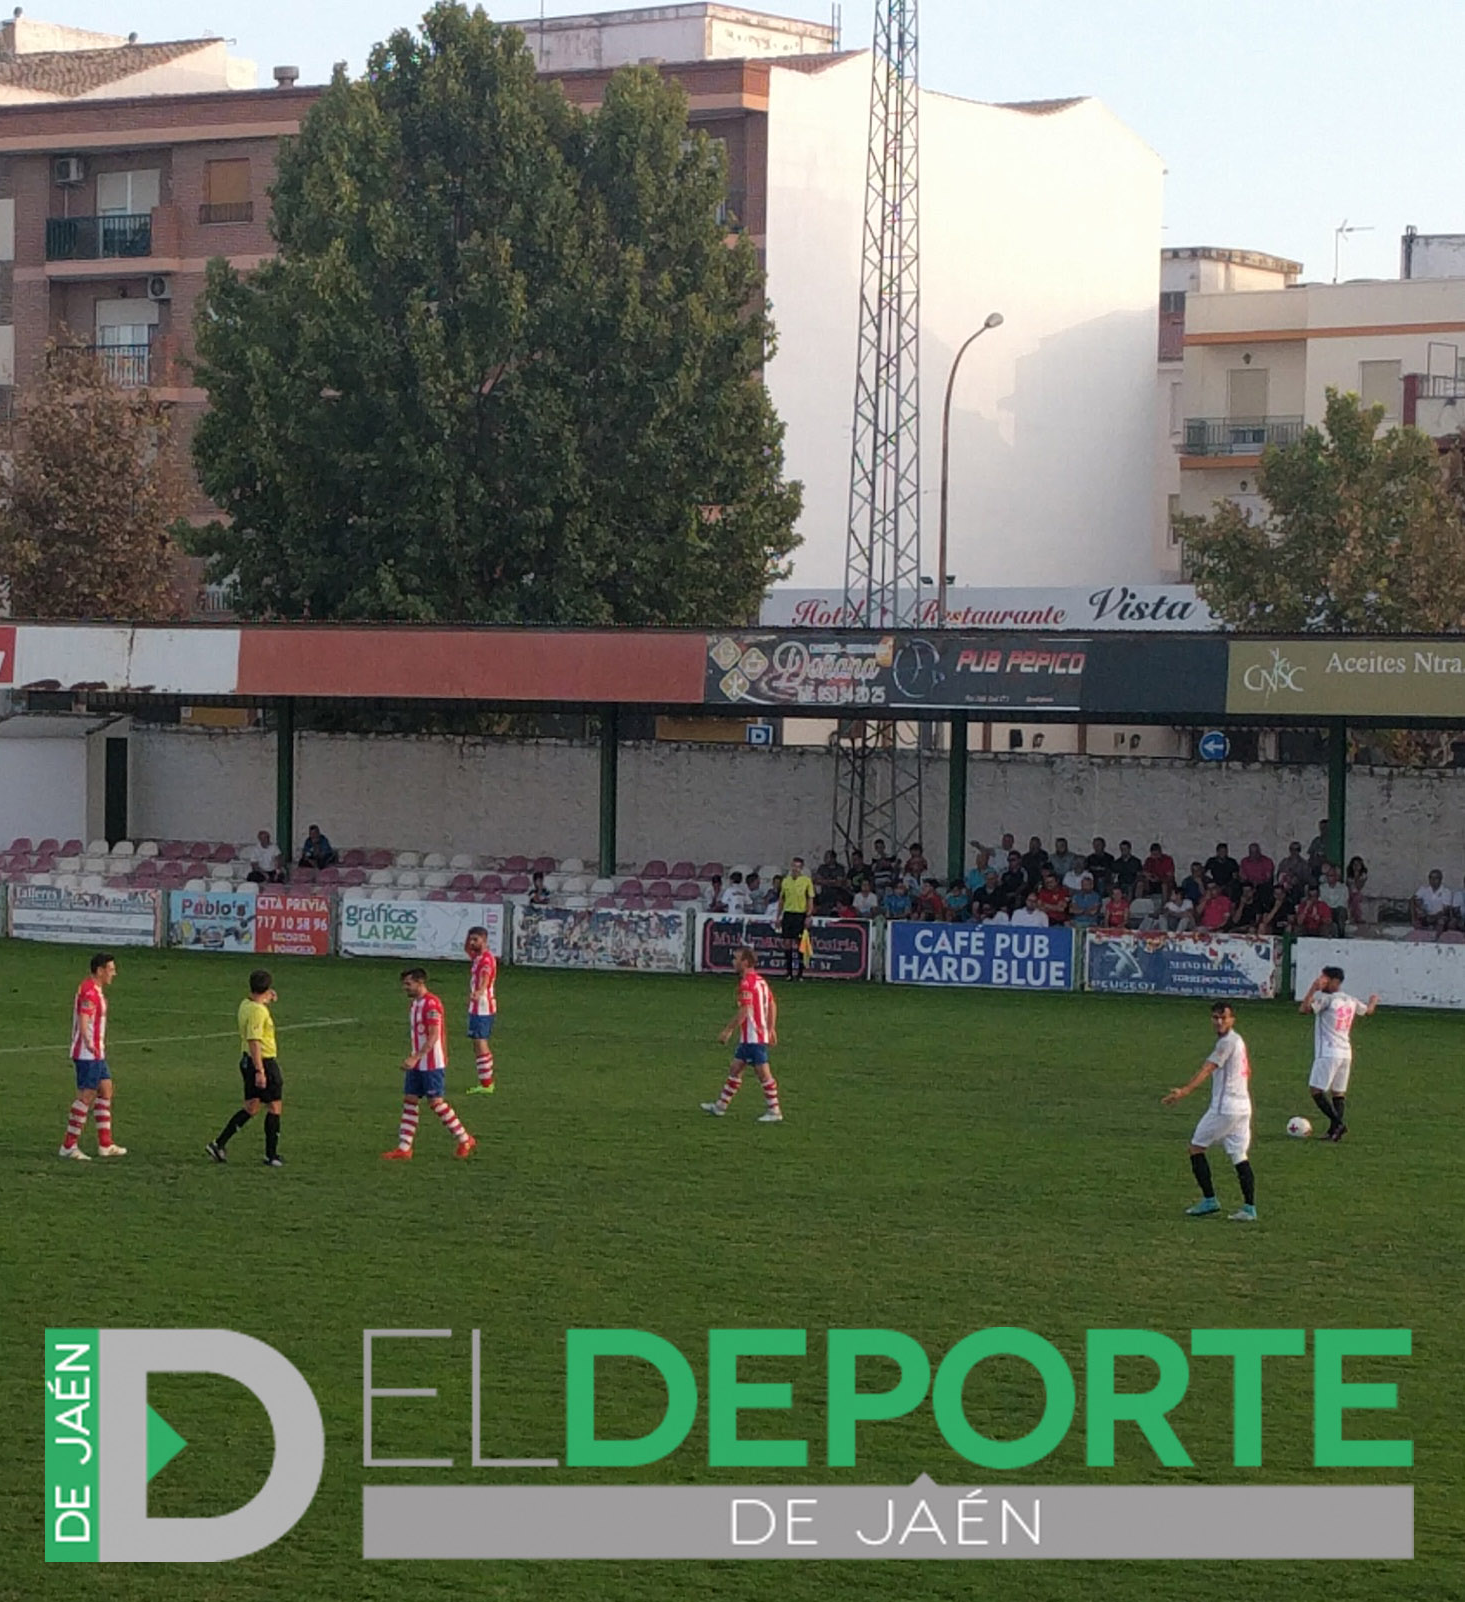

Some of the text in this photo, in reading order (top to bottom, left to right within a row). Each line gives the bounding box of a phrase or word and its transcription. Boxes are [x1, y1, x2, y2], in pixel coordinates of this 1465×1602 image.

[1089, 586, 1196, 621] Vista
[956, 650, 1002, 672] PUB
[1326, 651, 1406, 673] Aceites
[257, 915, 277, 929] 717
[281, 916, 295, 930] 10
[345, 904, 419, 926] gráficas
[357, 925, 417, 941] LA PAZ
[914, 924, 1050, 959] CAFÉ PUB
[898, 955, 1066, 987] HARD BLUE
